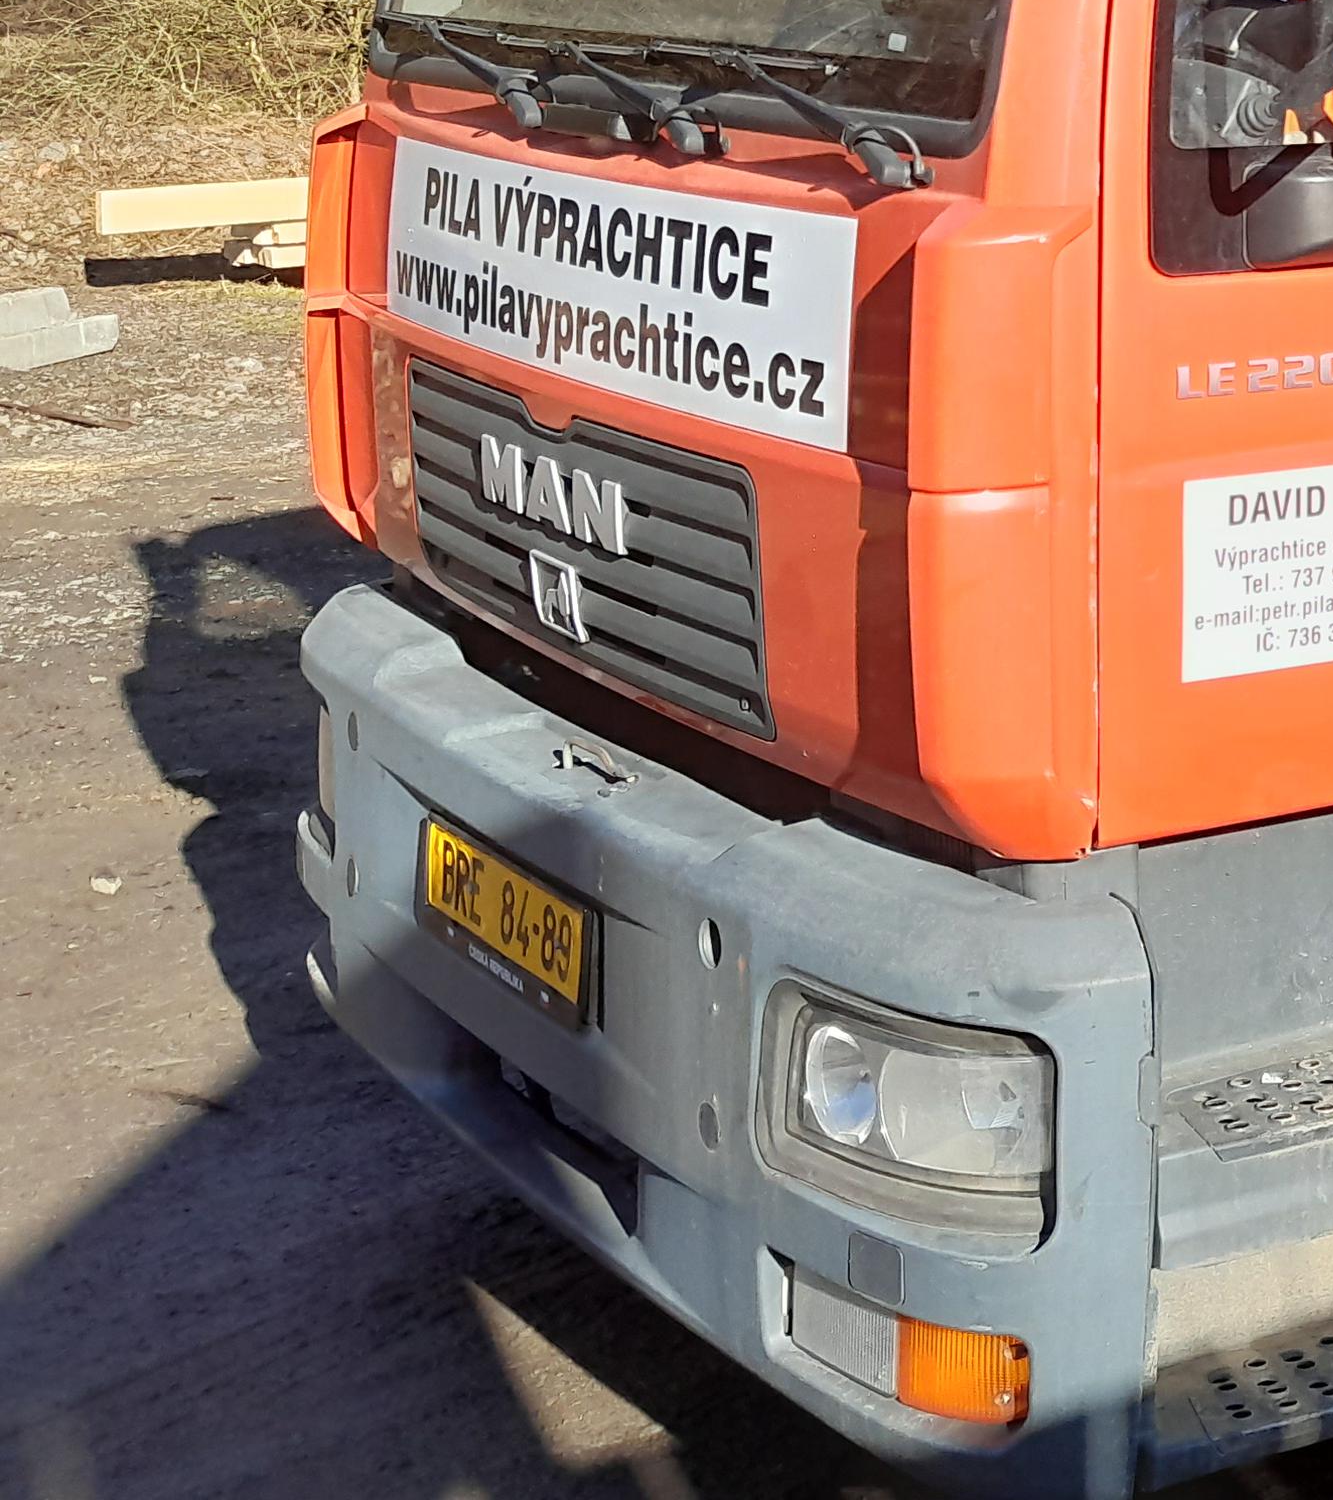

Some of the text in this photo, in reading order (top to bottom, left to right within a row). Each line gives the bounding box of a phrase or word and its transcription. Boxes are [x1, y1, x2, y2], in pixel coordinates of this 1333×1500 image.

[422, 166, 773, 308] PILA VÝPRACHTICE
[395, 248, 826, 418] www.pilavyprachtice.cz
[1176, 361, 1237, 400] LE
[480, 433, 629, 556] MAN
[1227, 484, 1327, 527] DAVID
[1214, 534, 1327, 572] Výprachtice
[1242, 574, 1285, 595] Tel.:
[1291, 566, 1325, 588] 737
[1255, 627, 1282, 654] IČ:
[1287, 624, 1322, 648] 736
[441, 839, 485, 927] BRE
